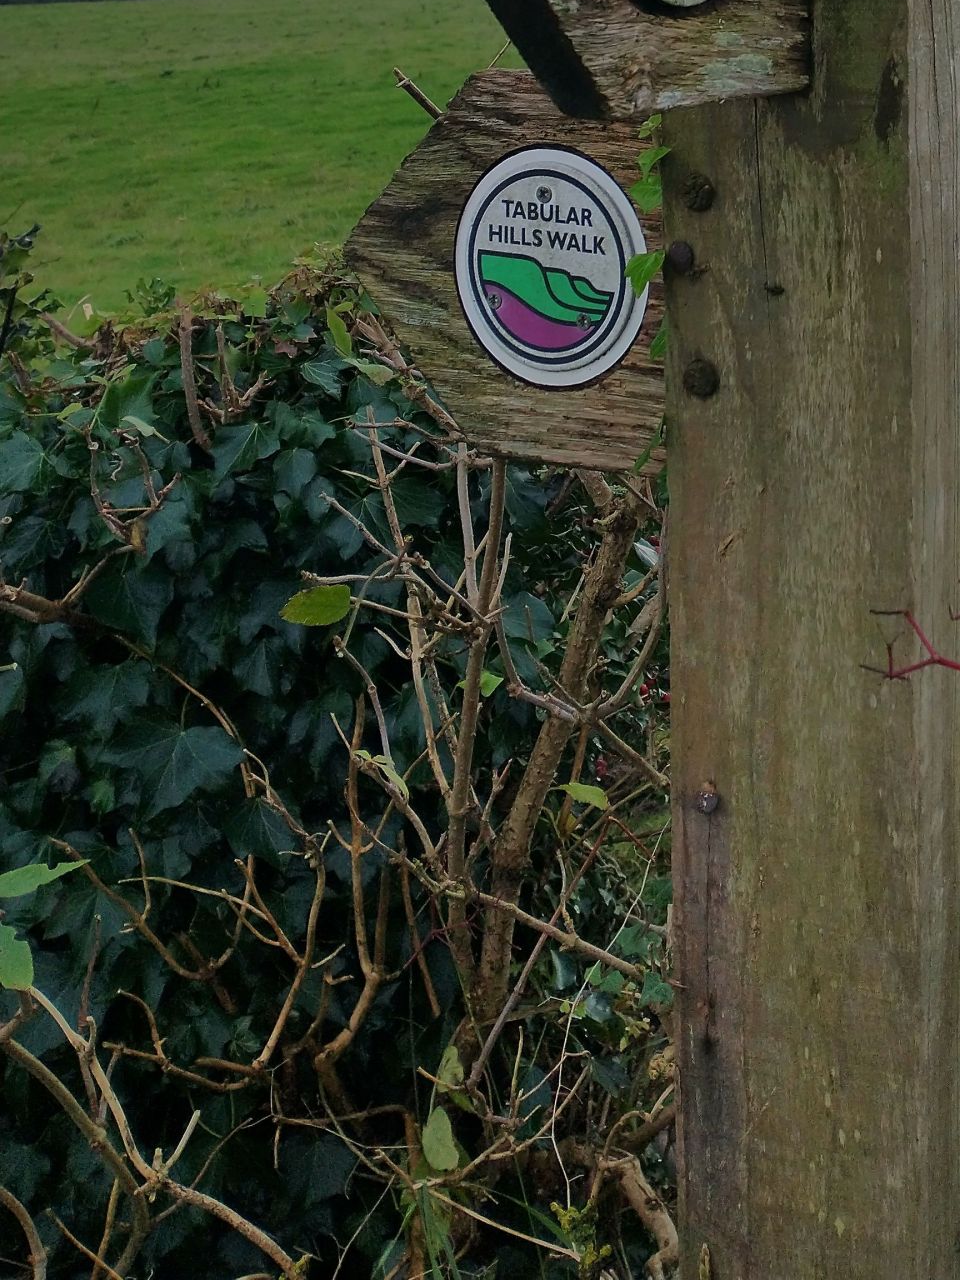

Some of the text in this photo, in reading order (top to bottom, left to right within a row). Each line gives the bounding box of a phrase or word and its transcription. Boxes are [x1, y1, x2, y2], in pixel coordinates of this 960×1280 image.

[501, 198, 593, 227] TABULAR
[488, 223, 607, 256] HILLS WALK
